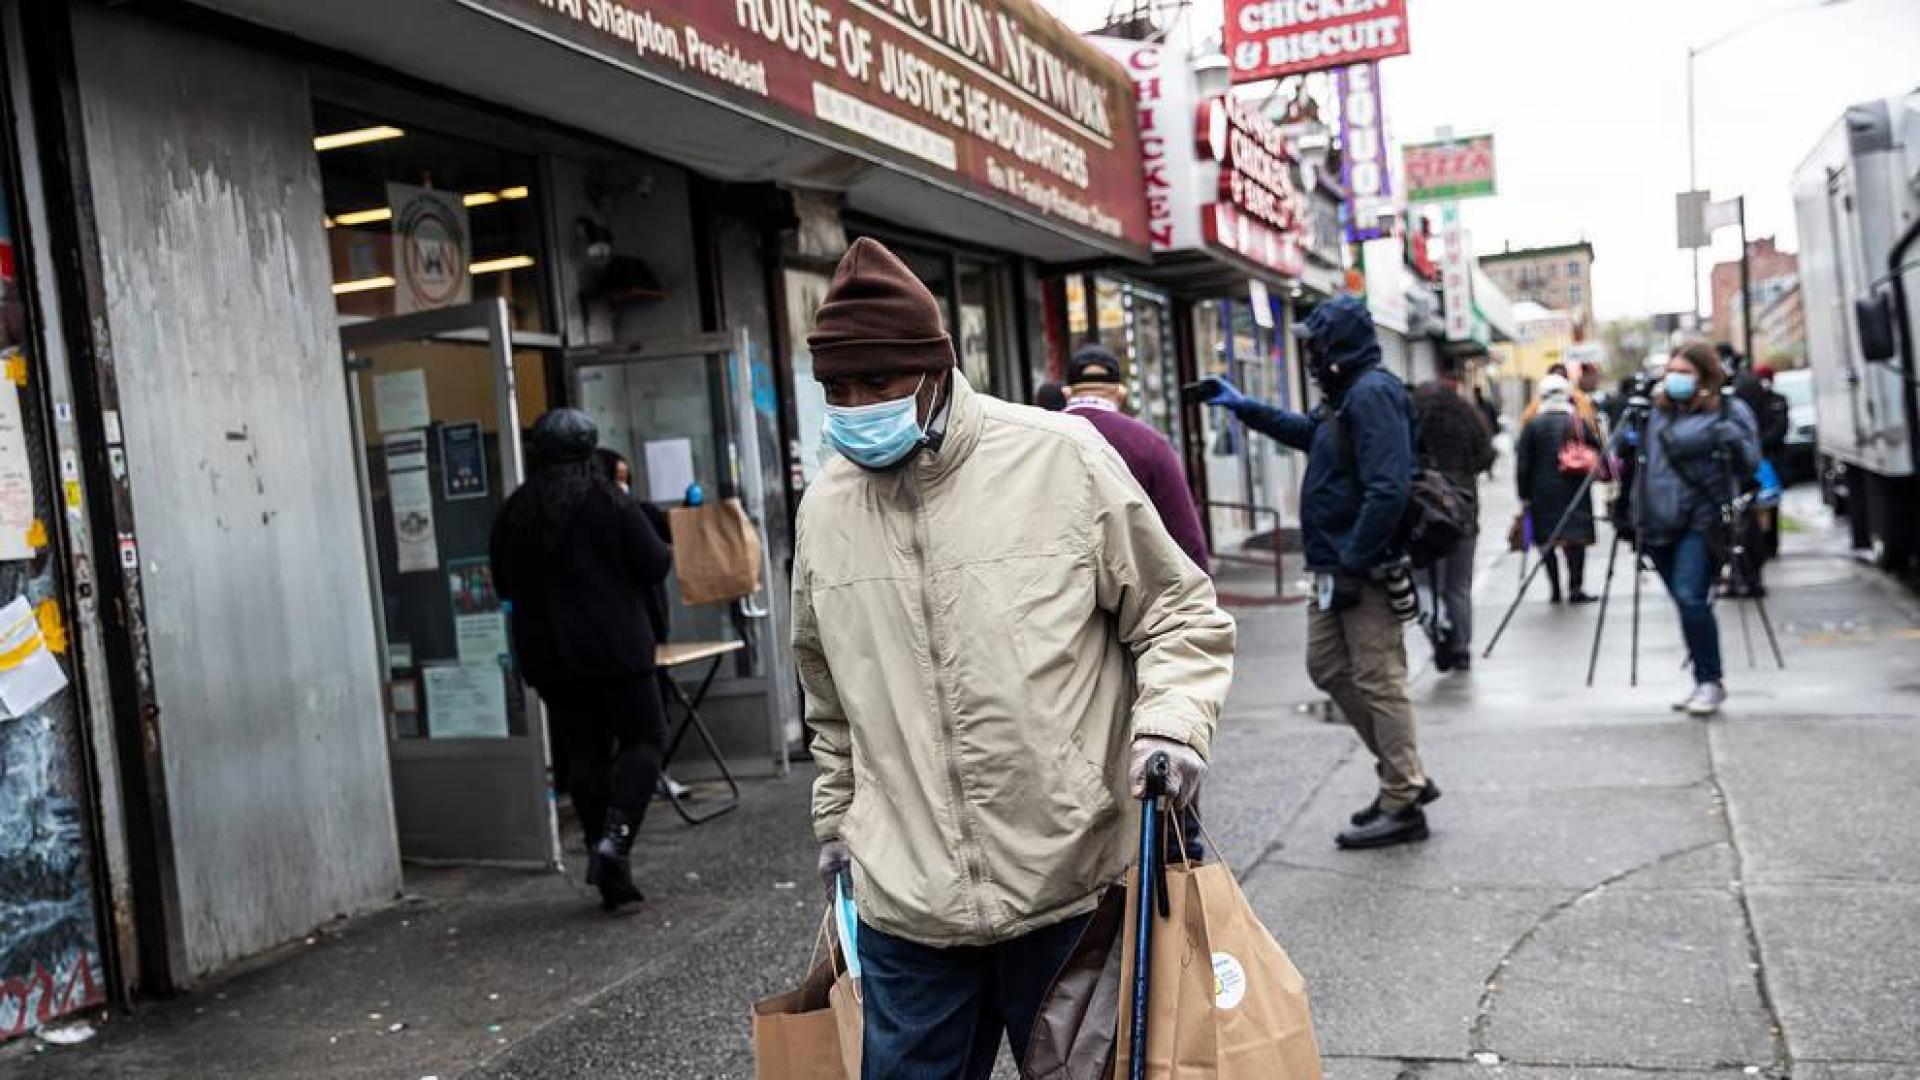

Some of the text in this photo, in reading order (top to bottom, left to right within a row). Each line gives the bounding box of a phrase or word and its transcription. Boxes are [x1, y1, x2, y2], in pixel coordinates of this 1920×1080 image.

[838, 19, 872, 83] OF
[879, 40, 963, 128] JUSTICE
[1234, 15, 1401, 71] & BISCUIT
